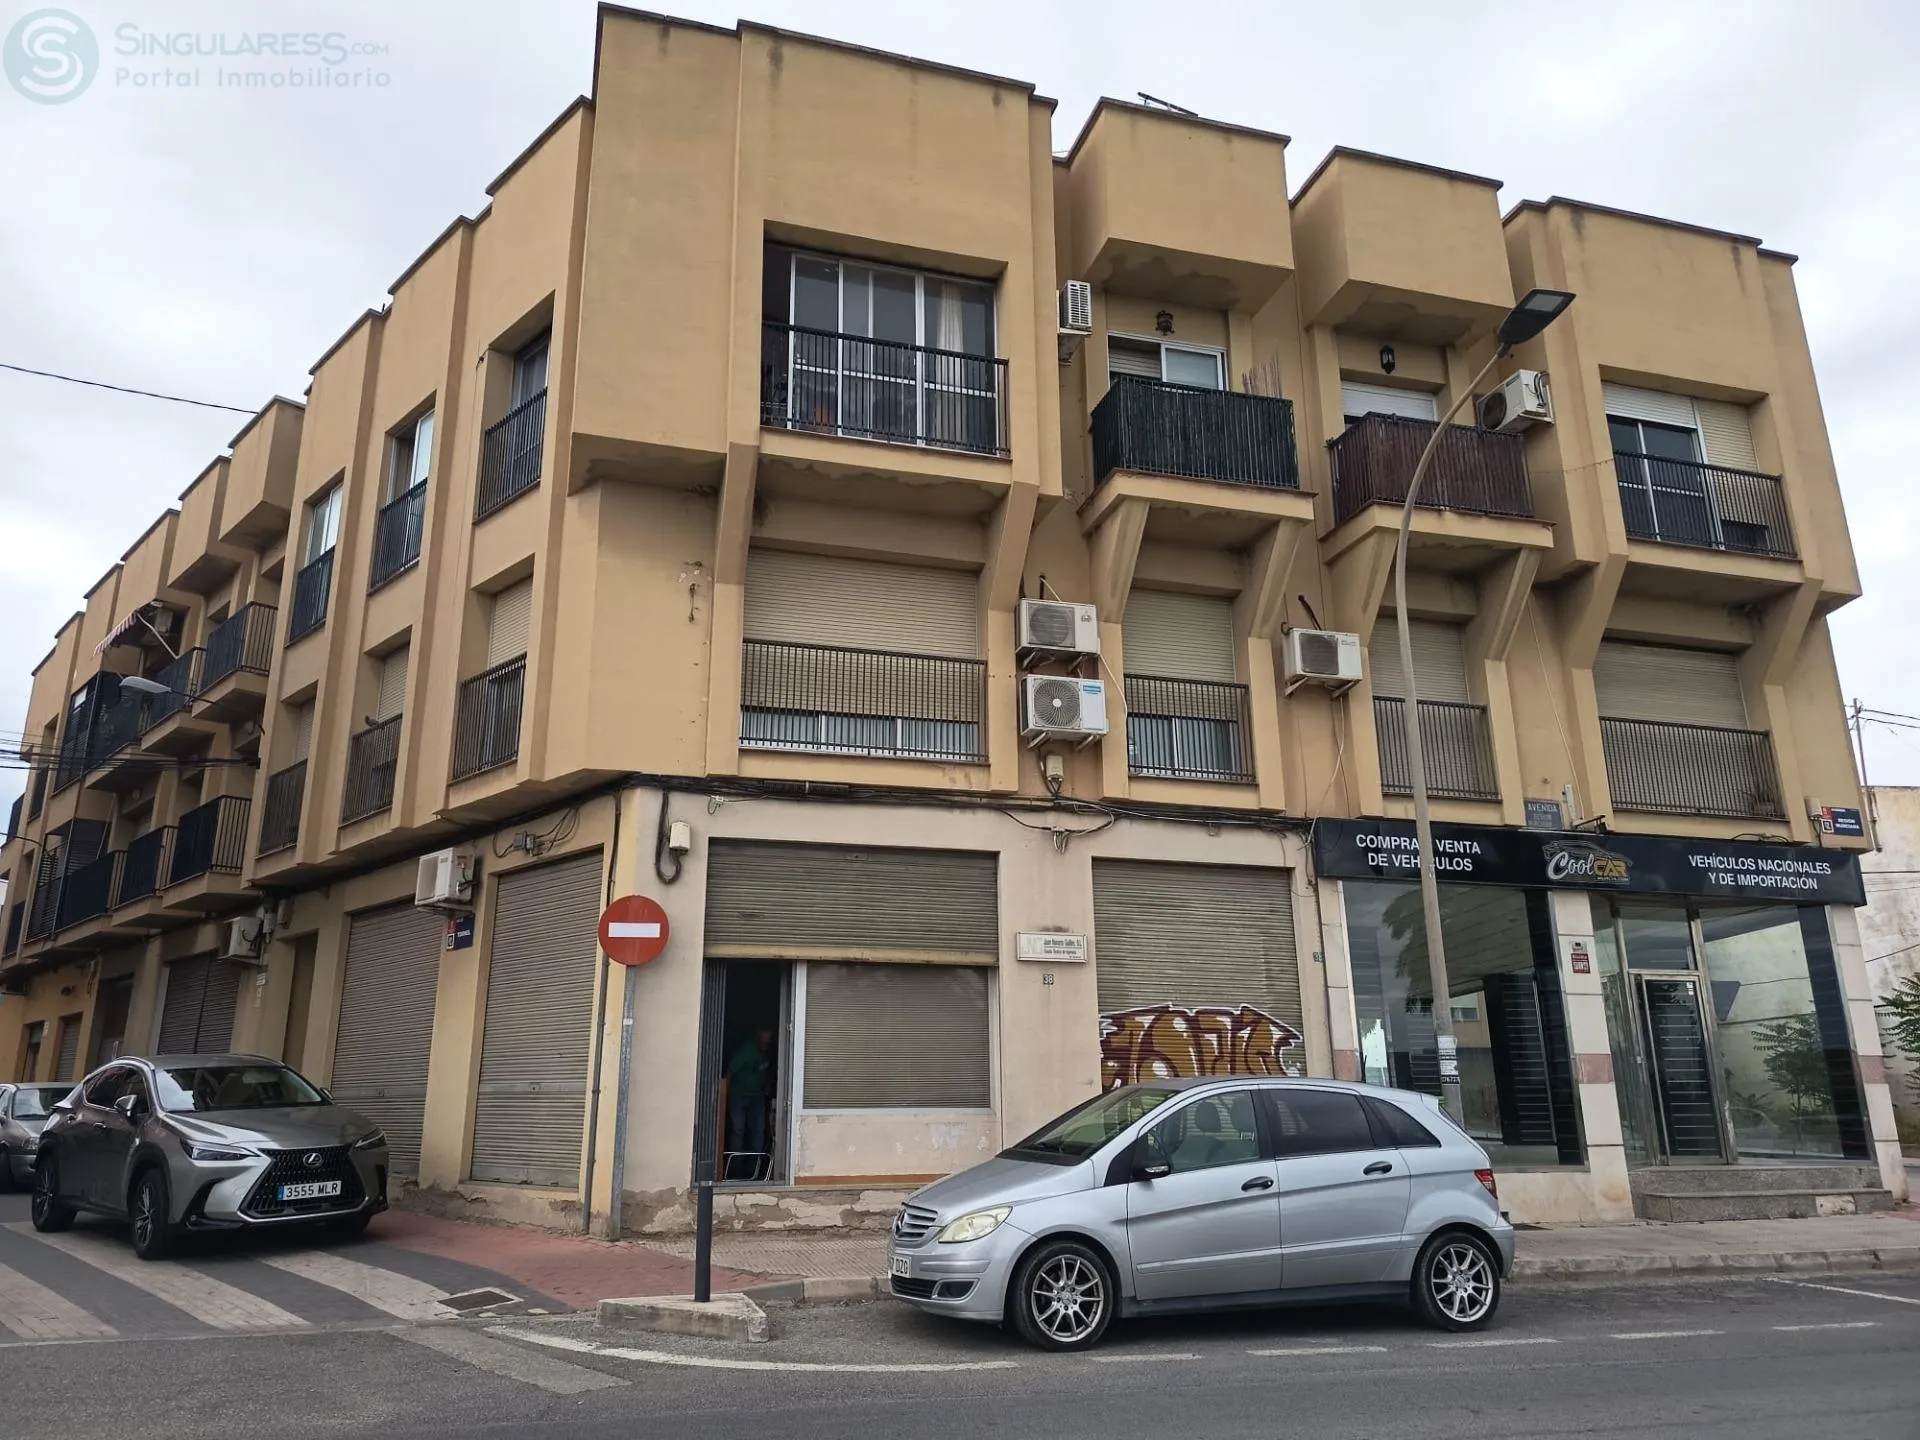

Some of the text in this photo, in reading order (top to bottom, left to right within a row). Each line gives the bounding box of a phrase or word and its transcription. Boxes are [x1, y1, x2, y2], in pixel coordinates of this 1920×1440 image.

[1355, 834, 1481, 854] COMPRA VENTA
[1367, 852, 1473, 871] DE VEHULOS
[1688, 852, 1832, 875] VEHÍCULOS NACIONALES
[1708, 872, 1818, 890] Y DE IMPORTACIÓN
[1043, 973, 1054, 984] 38
[286, 1182, 338, 1198] 3555 MLR
[896, 1258, 908, 1274] DZG
